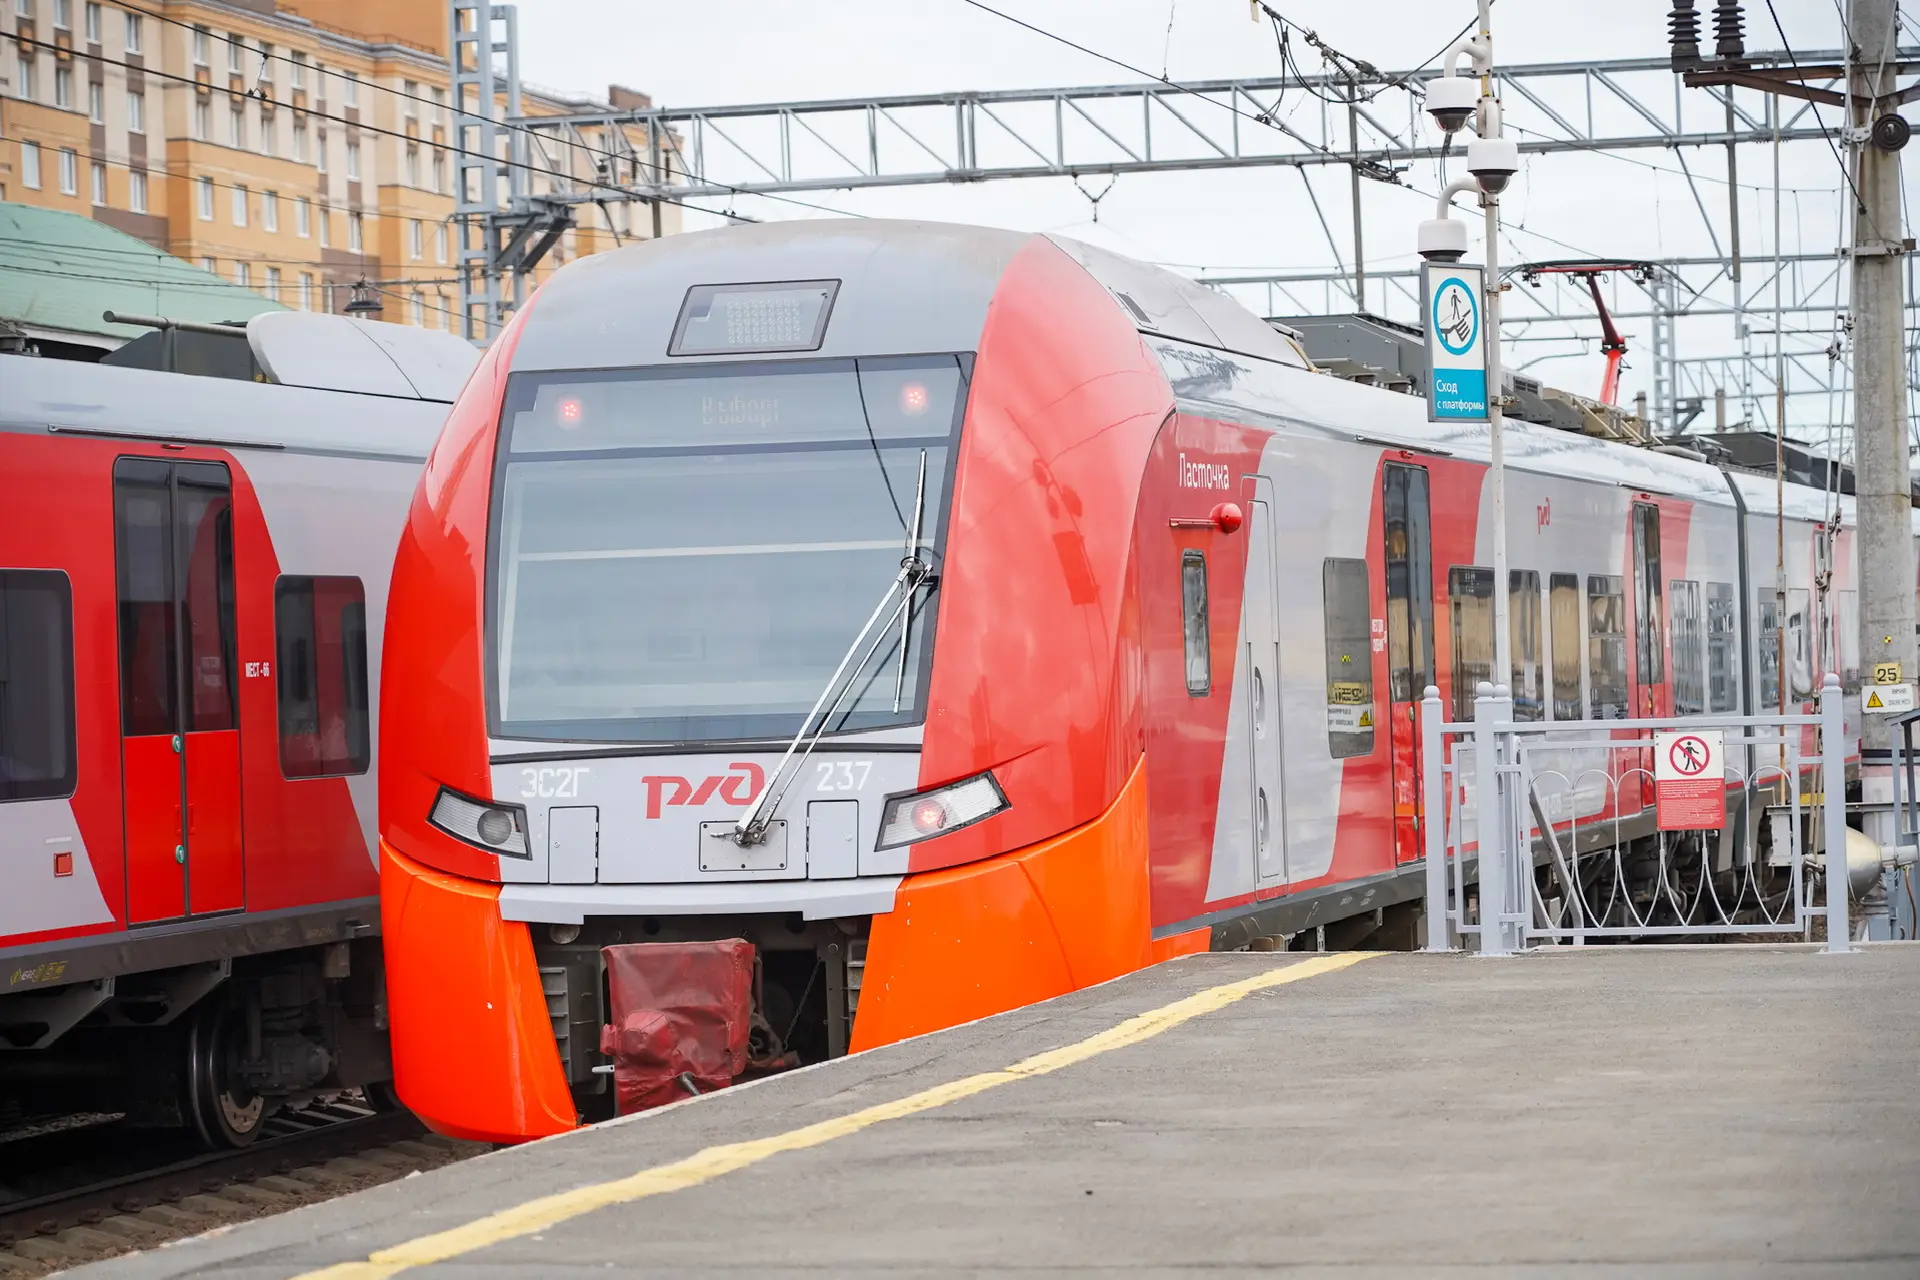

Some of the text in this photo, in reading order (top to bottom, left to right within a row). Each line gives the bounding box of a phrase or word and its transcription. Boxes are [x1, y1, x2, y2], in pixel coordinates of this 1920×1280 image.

[1436, 379, 1458, 394] Сход
[1437, 399, 1485, 412] с платформы
[1179, 452, 1230, 490] Ласточка
[1877, 667, 1897, 682] 25
[817, 761, 873, 791] 237
